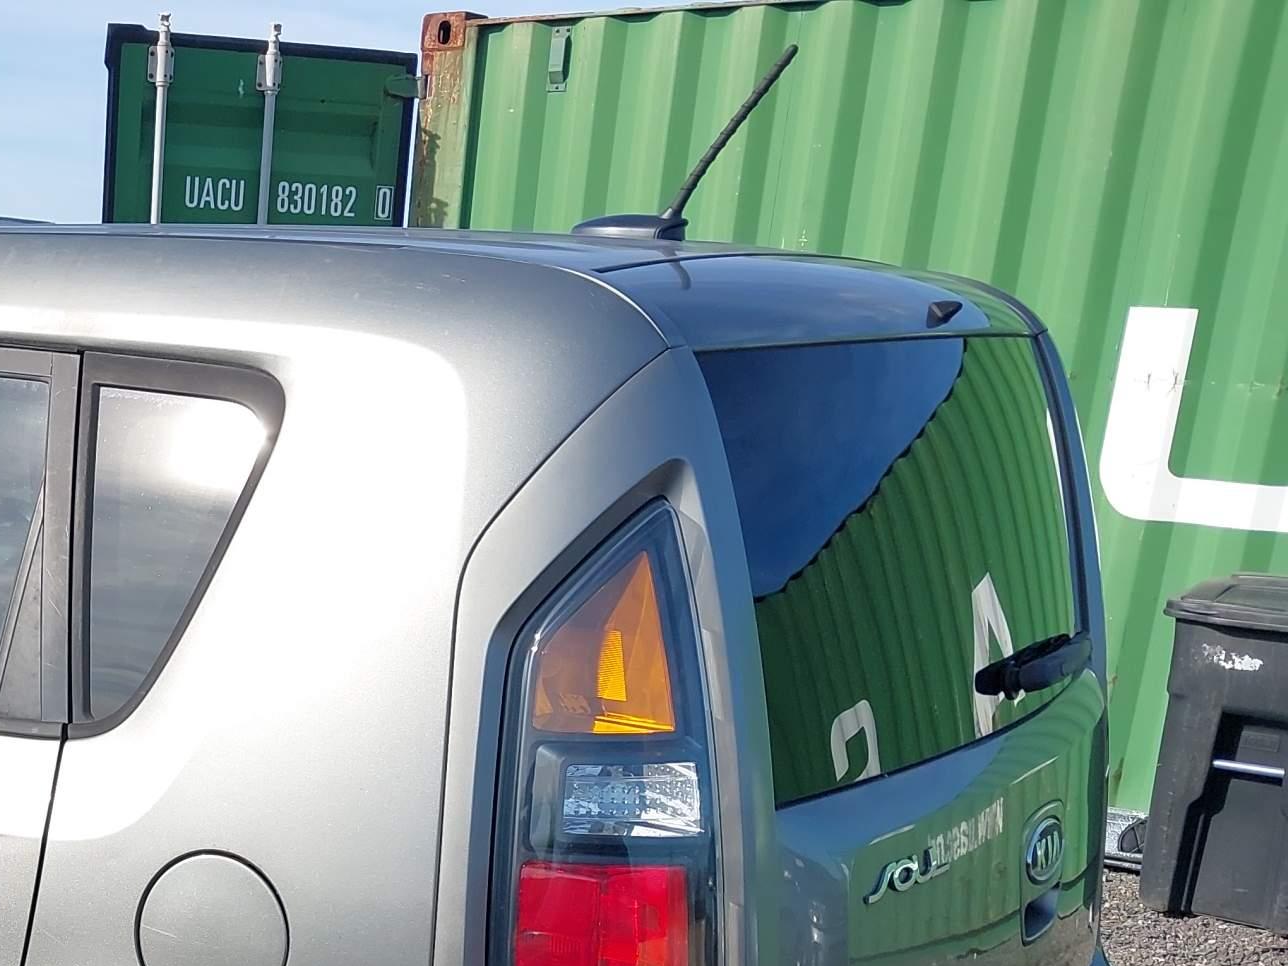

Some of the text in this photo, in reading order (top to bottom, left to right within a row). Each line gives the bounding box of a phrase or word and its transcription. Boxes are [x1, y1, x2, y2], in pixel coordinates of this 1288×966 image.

[185, 175, 391, 218] UACU 830182 0
[1034, 830, 1061, 872] KIA
